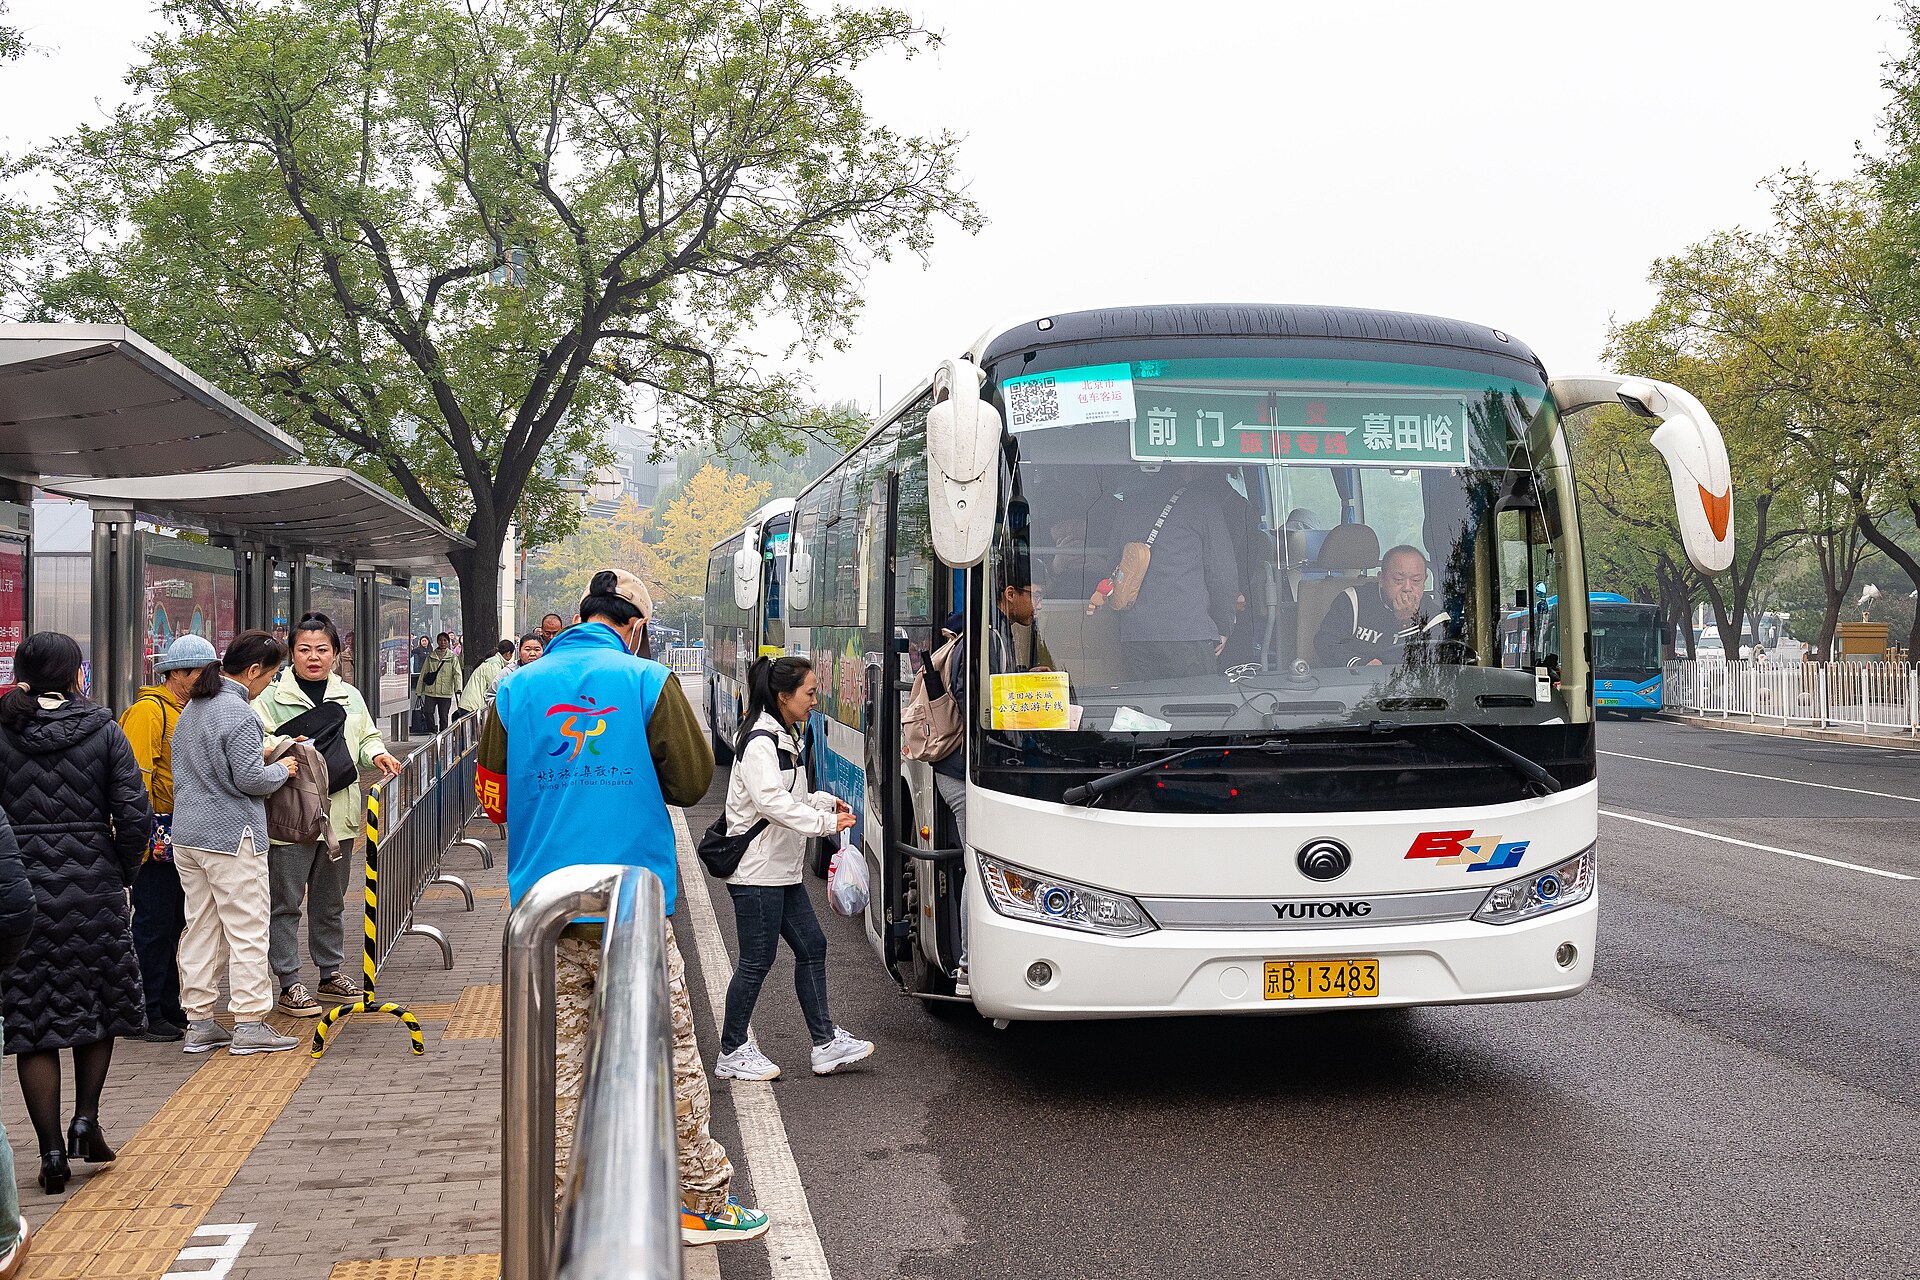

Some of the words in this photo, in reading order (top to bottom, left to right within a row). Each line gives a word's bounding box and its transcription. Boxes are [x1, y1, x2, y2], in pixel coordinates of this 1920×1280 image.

[1082, 378, 1114, 391] 北京市
[1078, 391, 1122, 403] 包车客运
[1147, 406, 1225, 447] 前门
[1362, 412, 1453, 452] 慕田峪
[1240, 431, 1348, 455] 旅游专线
[1008, 690, 1053, 701] 慕田峪长城
[999, 701, 1064, 713] 公交旅游专线
[1271, 901, 1372, 919] YUTONG
[1267, 965, 1376, 993] 京B·13483
